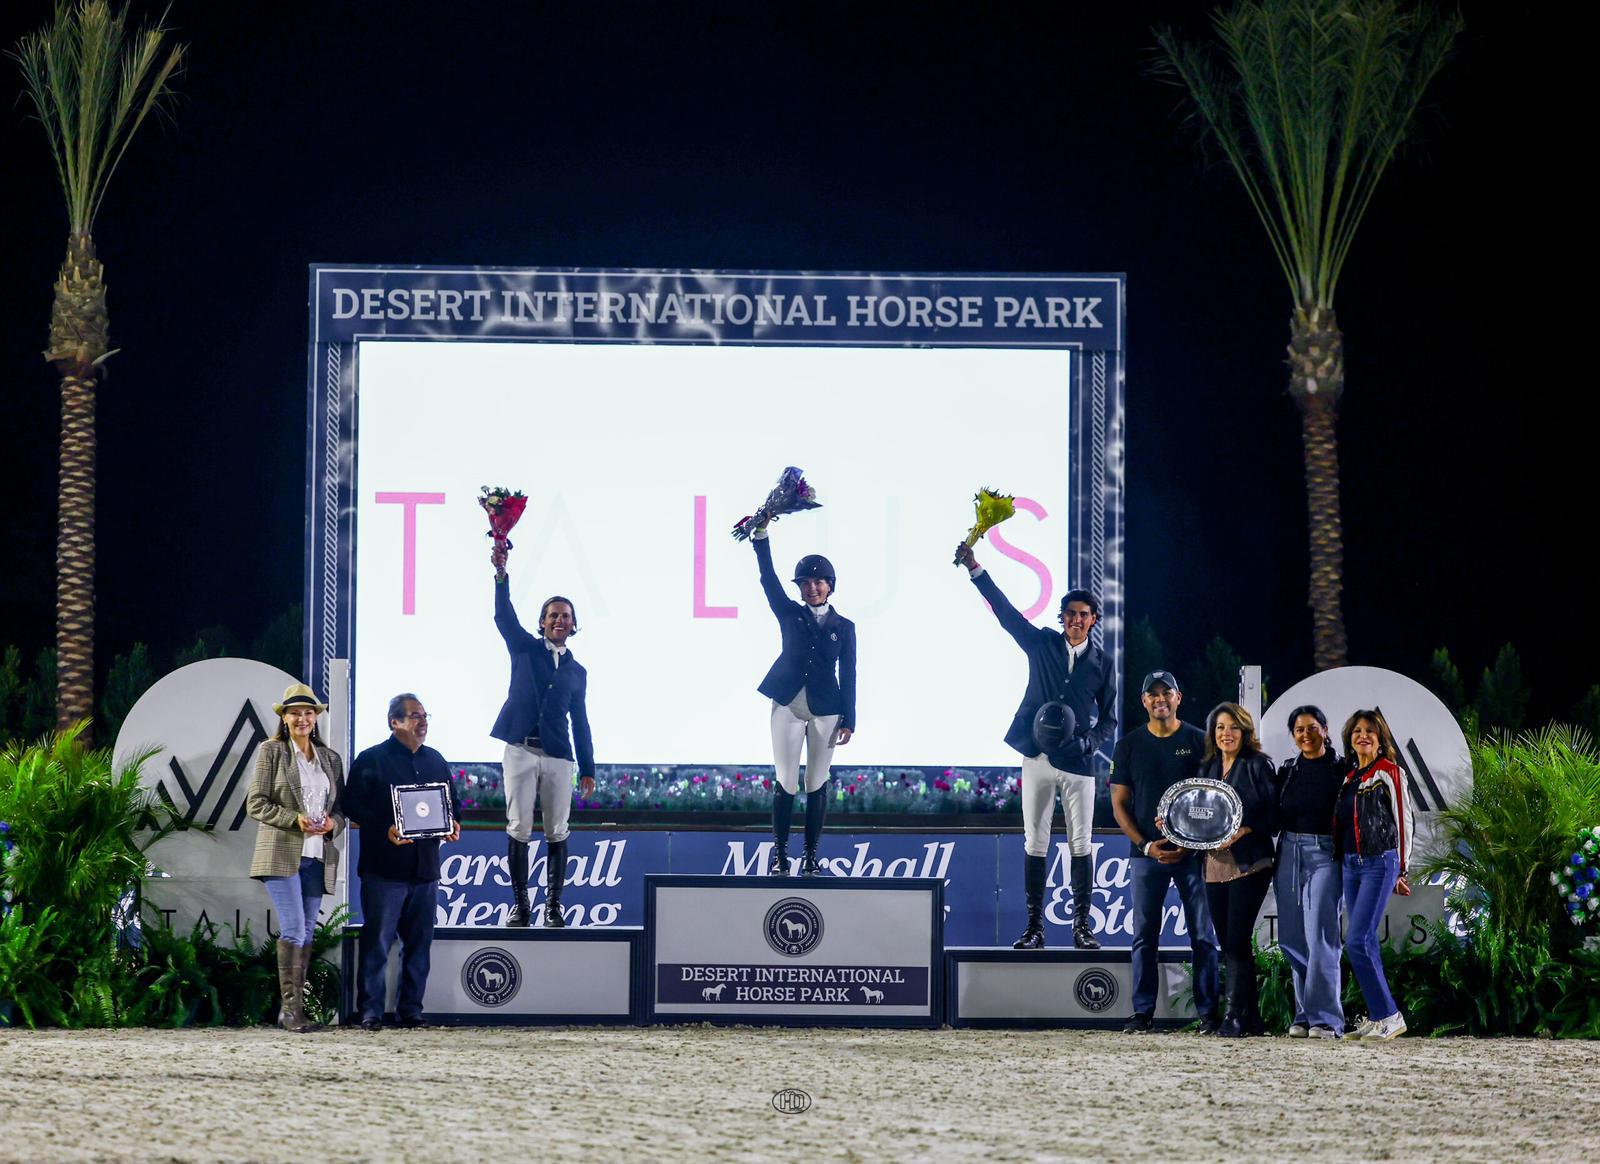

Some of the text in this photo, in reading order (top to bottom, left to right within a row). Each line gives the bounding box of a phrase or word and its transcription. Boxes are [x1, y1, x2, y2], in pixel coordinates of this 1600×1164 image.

[331, 287, 1103, 329] DESERT INTERNATIONAL HORSE PARK
[439, 839, 627, 887] arshall
[681, 966, 905, 984] DESERT INTERNATIONAL
[735, 986, 850, 1003] HORSE PARK
